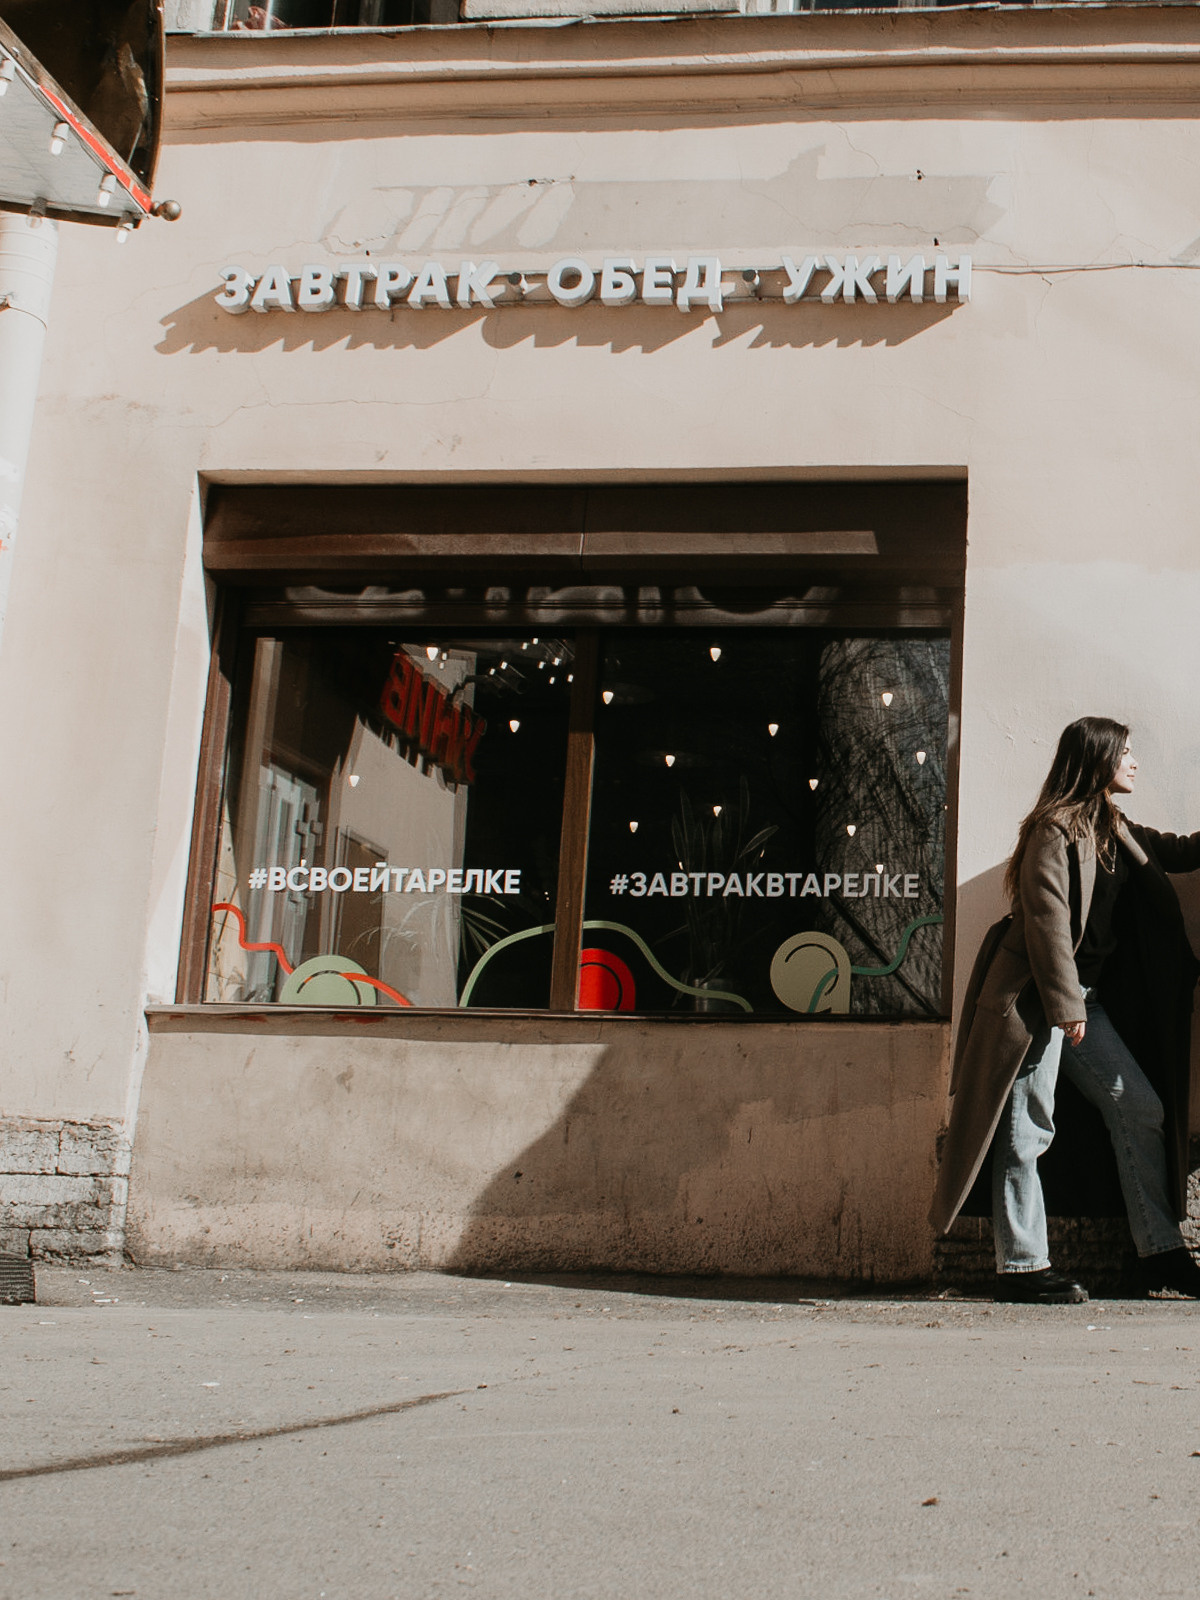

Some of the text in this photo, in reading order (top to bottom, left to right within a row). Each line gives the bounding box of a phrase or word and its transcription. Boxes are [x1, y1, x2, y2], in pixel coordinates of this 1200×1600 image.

[215, 254, 972, 314] ЗАВТРАК ОБЕД УЖИН
[248, 861, 521, 894] #ВСВОЕЙТАРЕЛКЕ
[609, 872, 920, 898] #ЗАВТРАКВТАРЕЛКЕ
